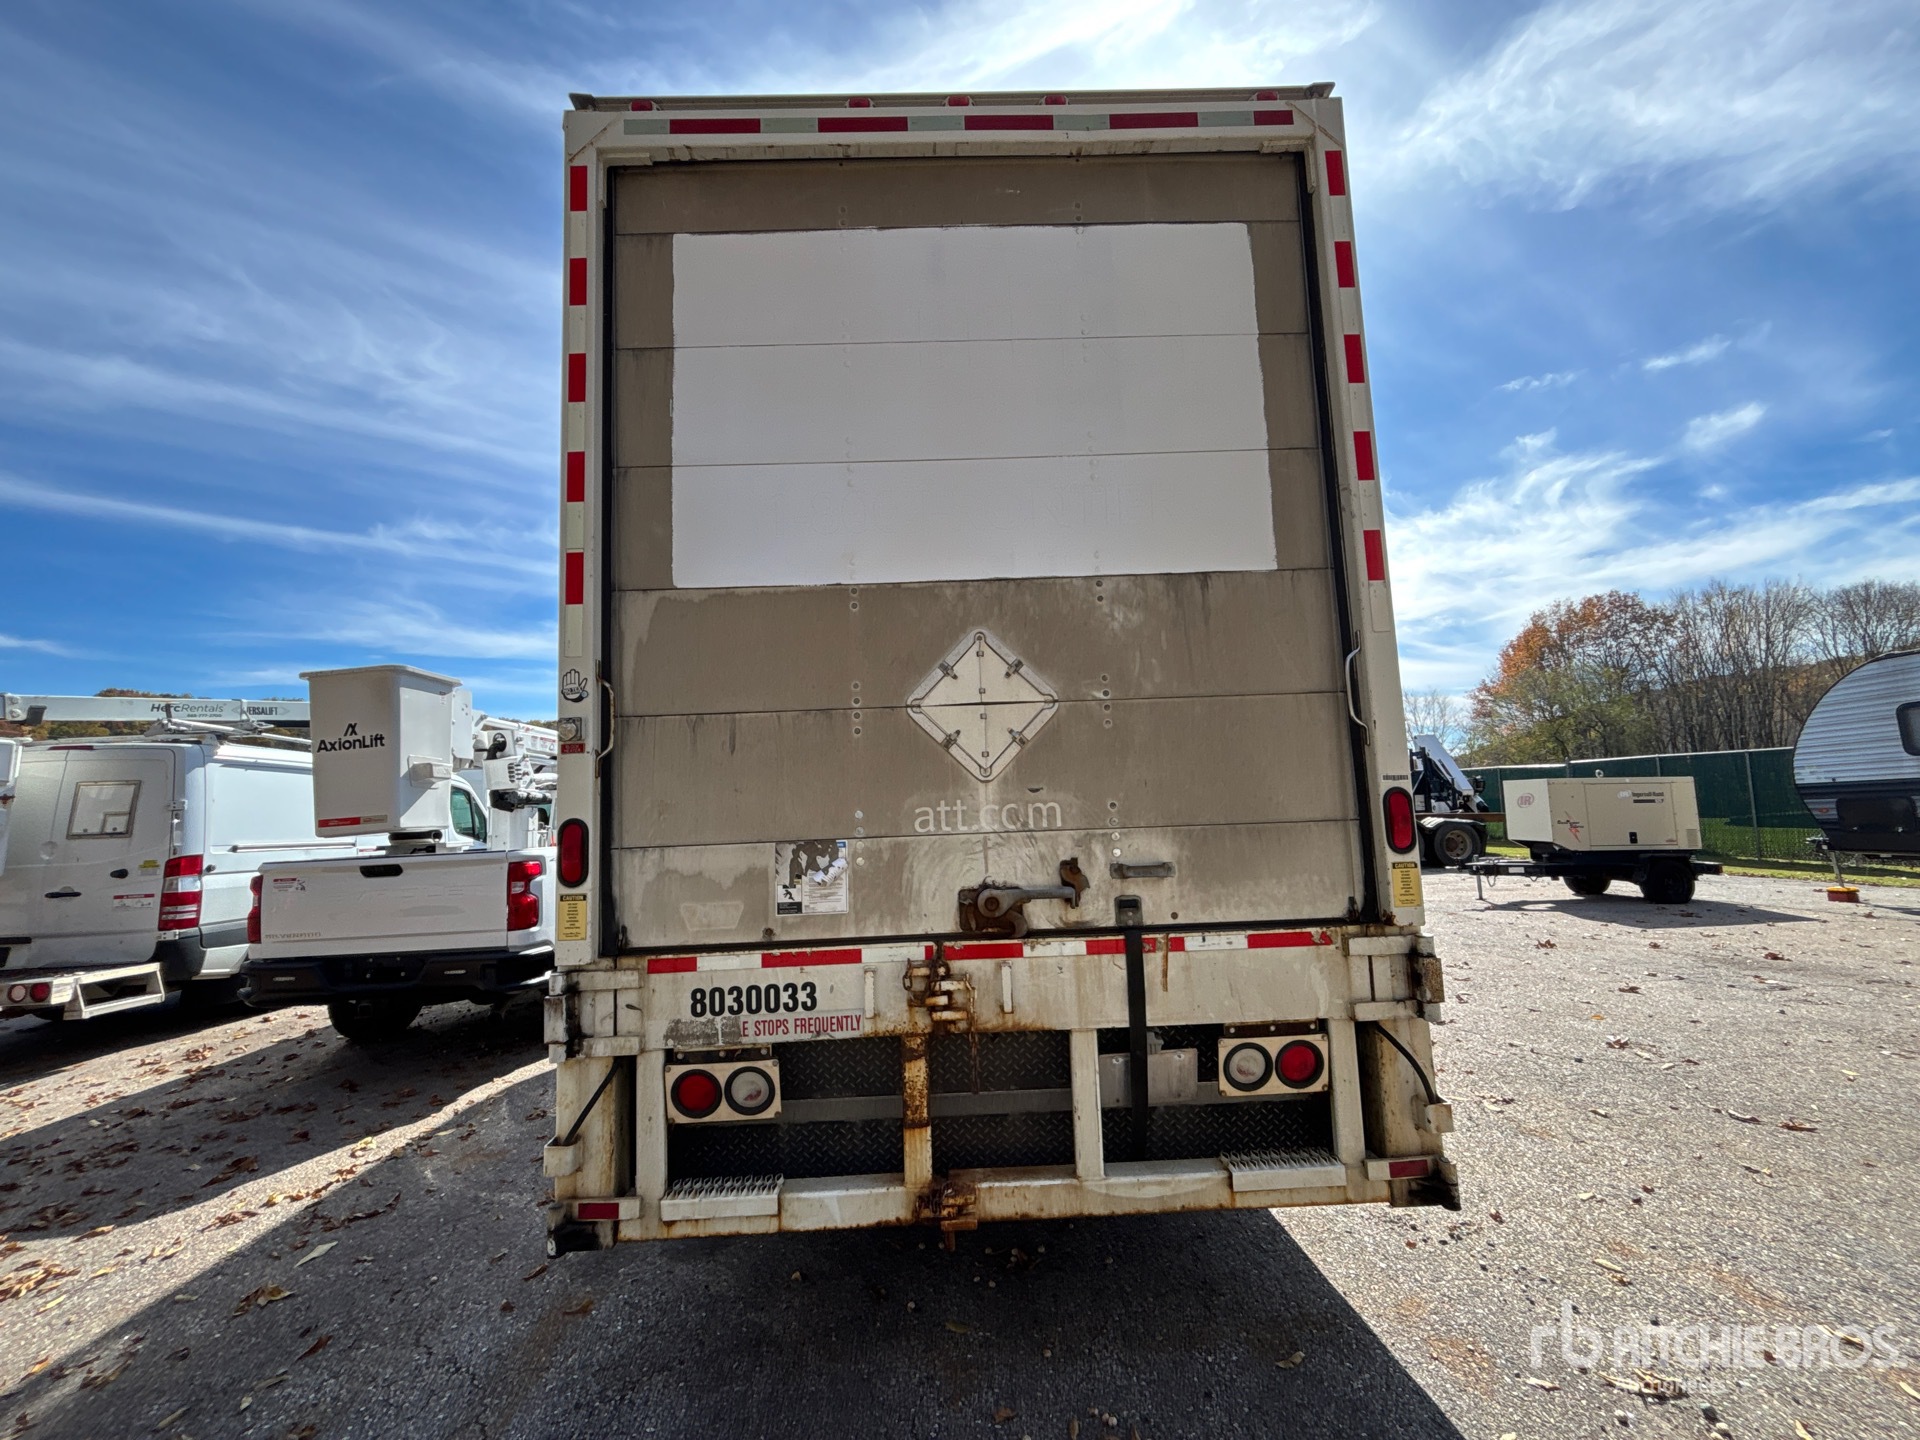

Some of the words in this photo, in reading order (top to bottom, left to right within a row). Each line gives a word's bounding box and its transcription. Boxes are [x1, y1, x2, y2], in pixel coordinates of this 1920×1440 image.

[316, 733, 385, 753] AxionLift
[914, 799, 1062, 833] att.com
[690, 981, 817, 1018] 8030033
[754, 1018, 789, 1037] STOPS
[793, 1014, 862, 1035] FREQUENTLY
